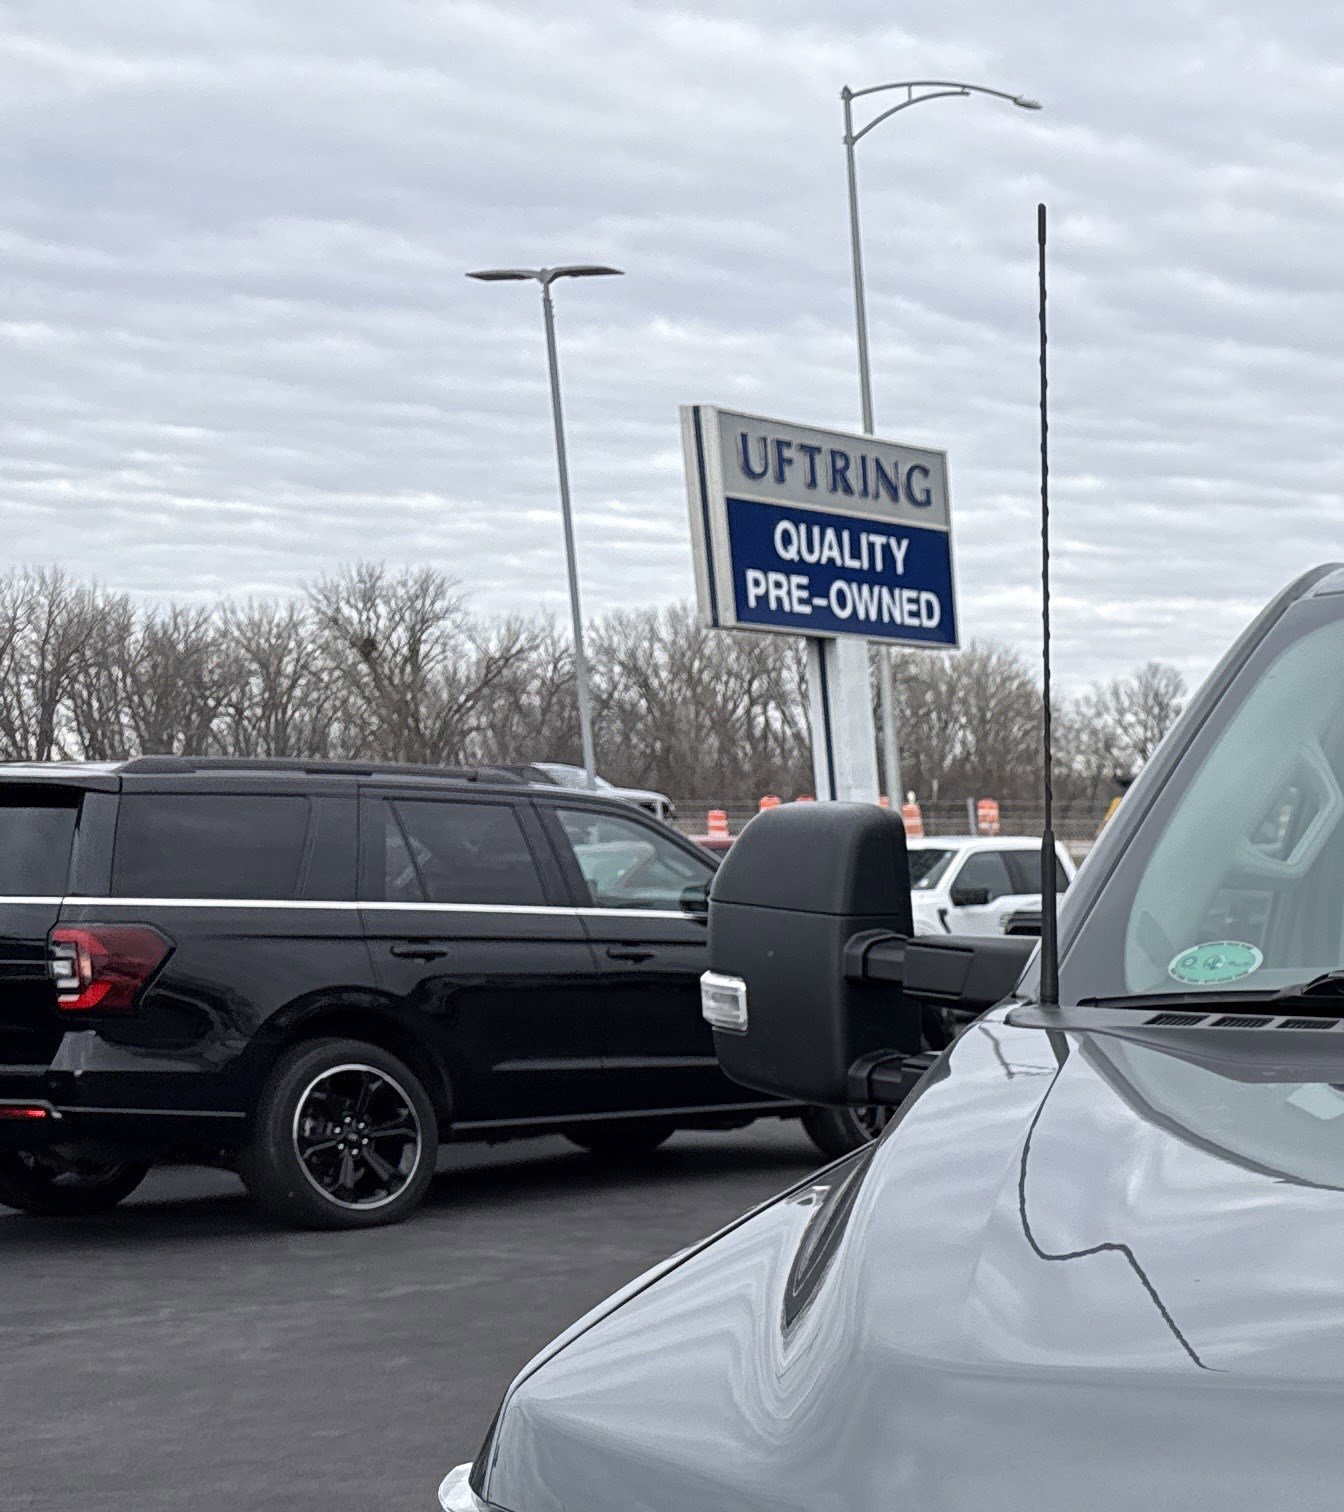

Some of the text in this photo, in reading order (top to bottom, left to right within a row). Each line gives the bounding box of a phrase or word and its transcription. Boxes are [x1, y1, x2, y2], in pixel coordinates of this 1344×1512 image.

[737, 432, 932, 507] UFTRING
[773, 519, 909, 575] QUALITY
[745, 568, 941, 628] PRE-OWNED
